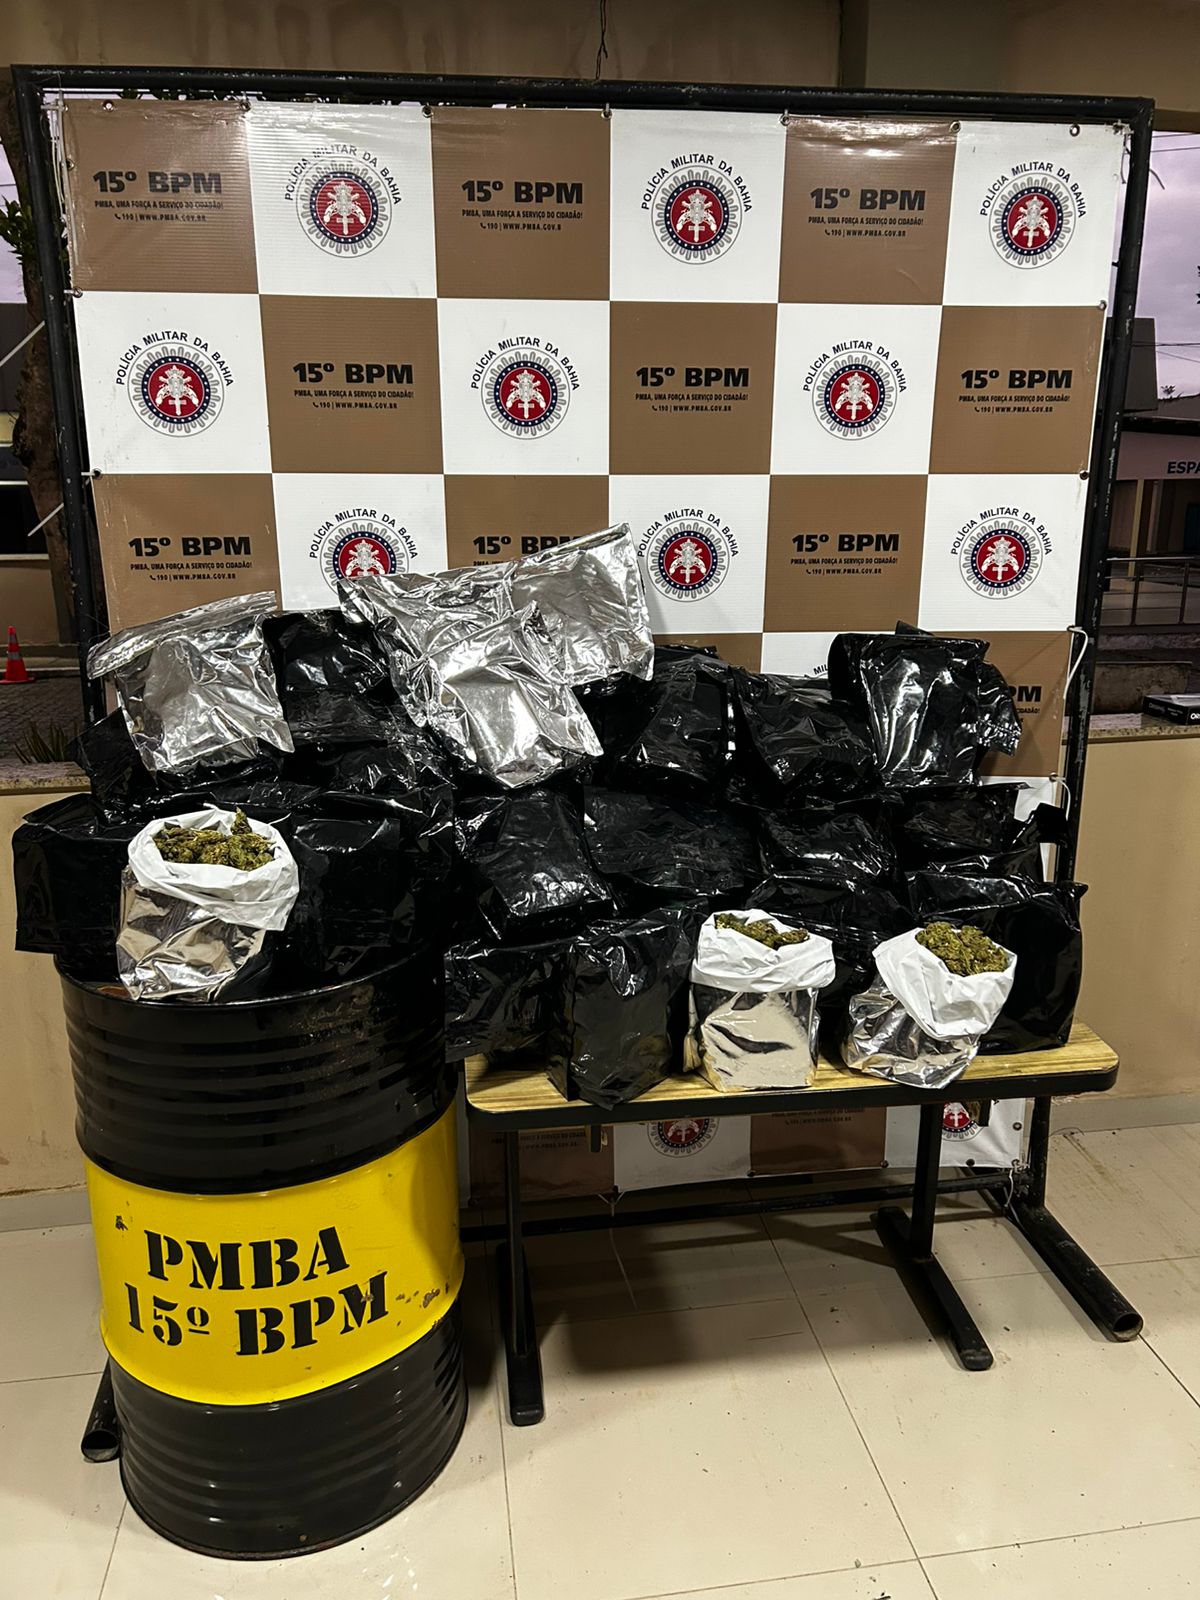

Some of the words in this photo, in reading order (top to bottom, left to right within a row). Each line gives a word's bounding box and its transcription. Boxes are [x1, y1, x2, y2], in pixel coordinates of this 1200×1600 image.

[92, 171, 137, 193] 15º
[148, 171, 221, 194] BPM
[362, 152, 378, 168] DA
[380, 167, 402, 205] BAHIA
[461, 180, 504, 202] 15º
[514, 181, 583, 204] BPM
[641, 167, 669, 210] POLÍCIA
[670, 153, 714, 169] MILITAR
[718, 160, 733, 176] DA
[734, 176, 752, 212] BAHIA
[810, 188, 850, 209] 15º
[859, 189, 926, 211] BPM
[980, 175, 1009, 216] POLÍCIA
[1011, 161, 1054, 176] MILITAR
[1056, 167, 1071, 183] DA
[1070, 182, 1087, 218] BAHIA
[116, 344, 142, 385] POLÍCIA
[142, 330, 188, 346] MILITAR
[193, 337, 209, 352] DA
[211, 352, 234, 387] BAHIA
[292, 362, 335, 383] 15º
[345, 363, 414, 384] BPM
[471, 349, 497, 389] POLÍCIA
[498, 336, 541, 351] MILITAR
[545, 342, 560, 357] DA
[560, 357, 580, 391] BAHIA
[636, 367, 675, 387] 15º
[685, 367, 749, 387] BPM
[803, 353, 830, 392] POLÍCIA
[832, 340, 873, 354] MILITAR
[876, 346, 890, 360] DA
[890, 359, 907, 393] BAHIA
[961, 370, 999, 389] 15º
[1008, 370, 1073, 389] BPM
[128, 537, 171, 557] 15º
[181, 536, 251, 556] BPM
[309, 521, 334, 559] POLÍCIA
[334, 508, 377, 522] MILITAR
[381, 514, 396, 528] DA
[398, 527, 418, 559] BAHIA
[472, 536, 512, 555] 15º
[521, 536, 581, 555] BP
[637, 521, 663, 557] POLÍCIA
[664, 508, 704, 522] MILITAR
[707, 513, 721, 527] DA
[721, 526, 739, 557] BAHIA
[792, 534, 829, 552] 15º
[838, 533, 899, 552] BPM
[950, 519, 978, 555] POLÍCIA
[979, 507, 1019, 520] MILITAR
[1022, 512, 1036, 525] DA
[1036, 525, 1053, 555] BAHIA
[144, 1226, 350, 1291] PMBA
[124, 1282, 210, 1347] 15º
[235, 1270, 389, 1356] BPM
